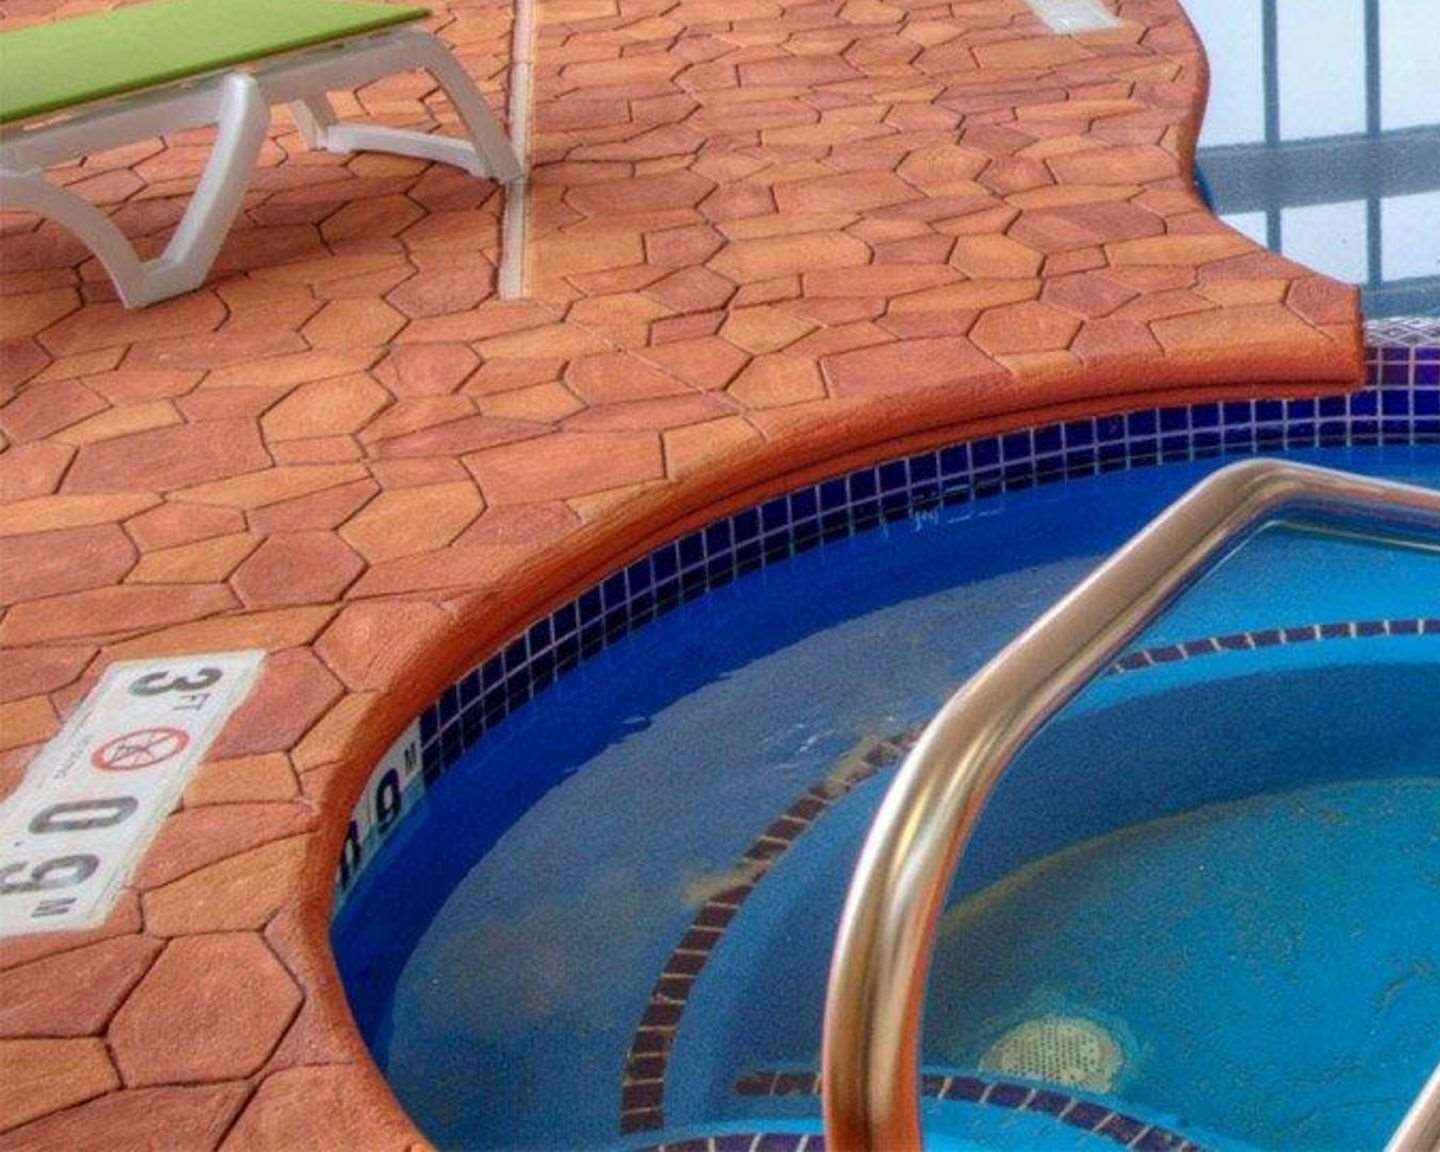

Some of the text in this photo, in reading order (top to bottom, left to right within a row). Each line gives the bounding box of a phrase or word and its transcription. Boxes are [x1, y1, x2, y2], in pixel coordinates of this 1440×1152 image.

[129, 668, 223, 696] 3
[172, 693, 211, 711] FT
[30, 896, 78, 918] M
